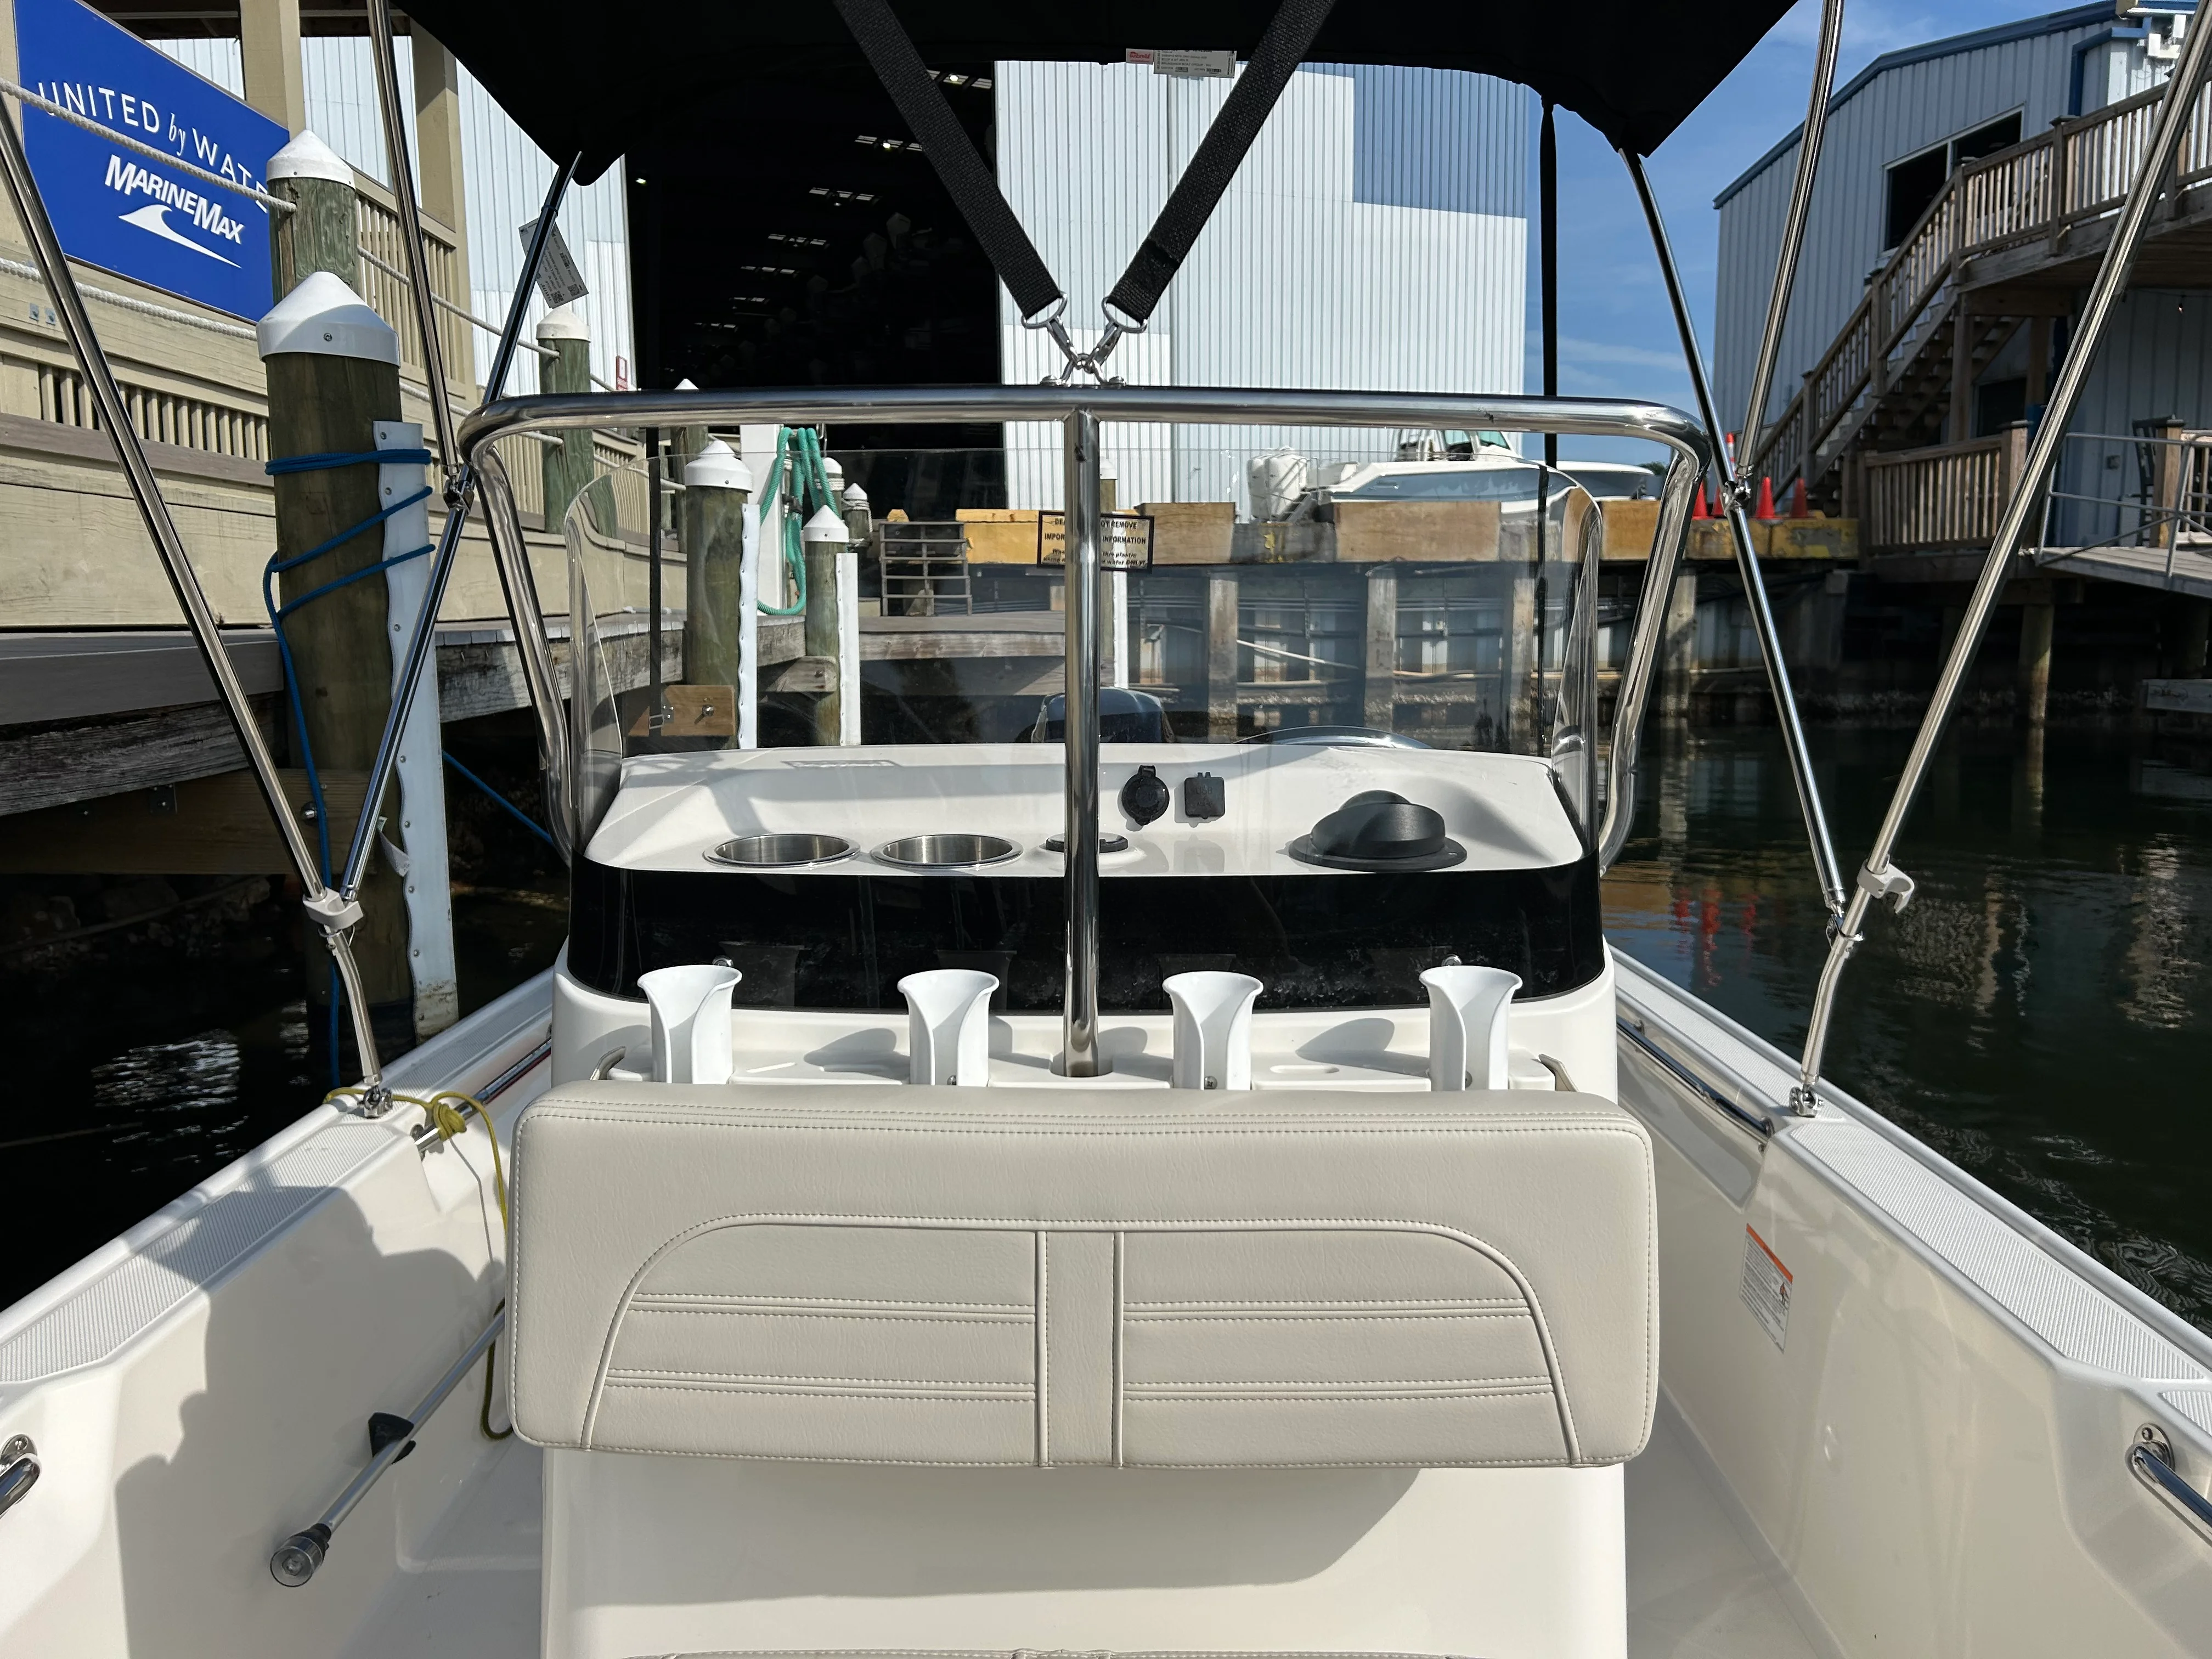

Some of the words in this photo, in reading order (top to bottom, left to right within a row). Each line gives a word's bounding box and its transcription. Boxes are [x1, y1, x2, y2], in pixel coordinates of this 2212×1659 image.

[38, 82, 160, 133] UNITED
[168, 112, 186, 156] by
[1111, 521, 1137, 529] REMOVE
[1102, 536, 1146, 544] INFORMATION
